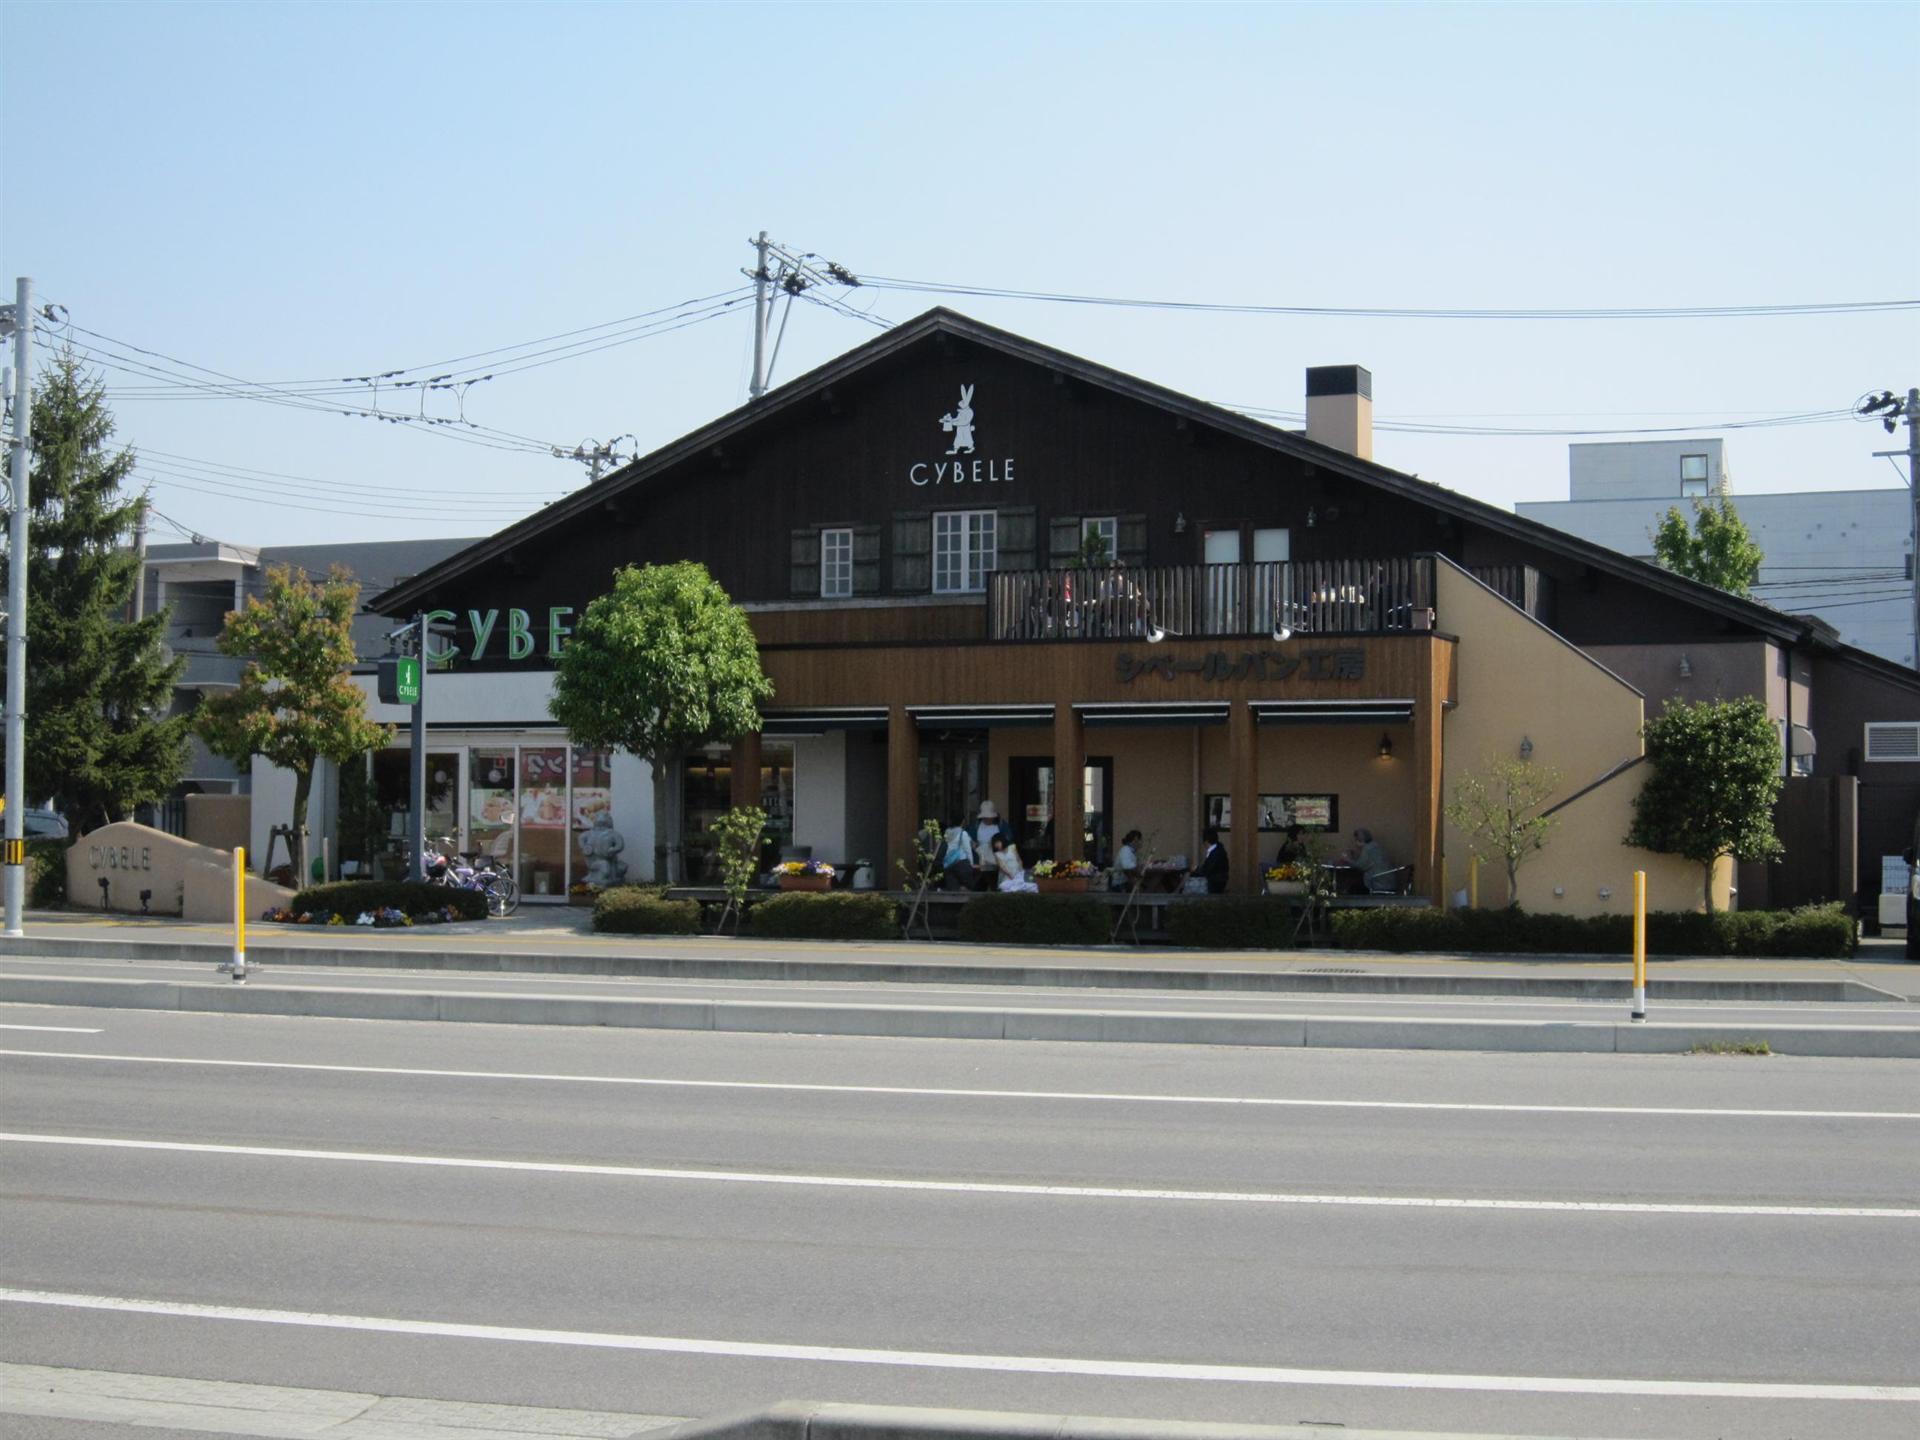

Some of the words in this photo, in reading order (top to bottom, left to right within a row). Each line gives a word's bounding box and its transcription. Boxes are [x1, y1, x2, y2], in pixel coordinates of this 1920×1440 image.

[910, 458, 1014, 486] CYBELE
[1116, 646, 1365, 684] シベールパン工房
[88, 846, 151, 870] CYBELE
